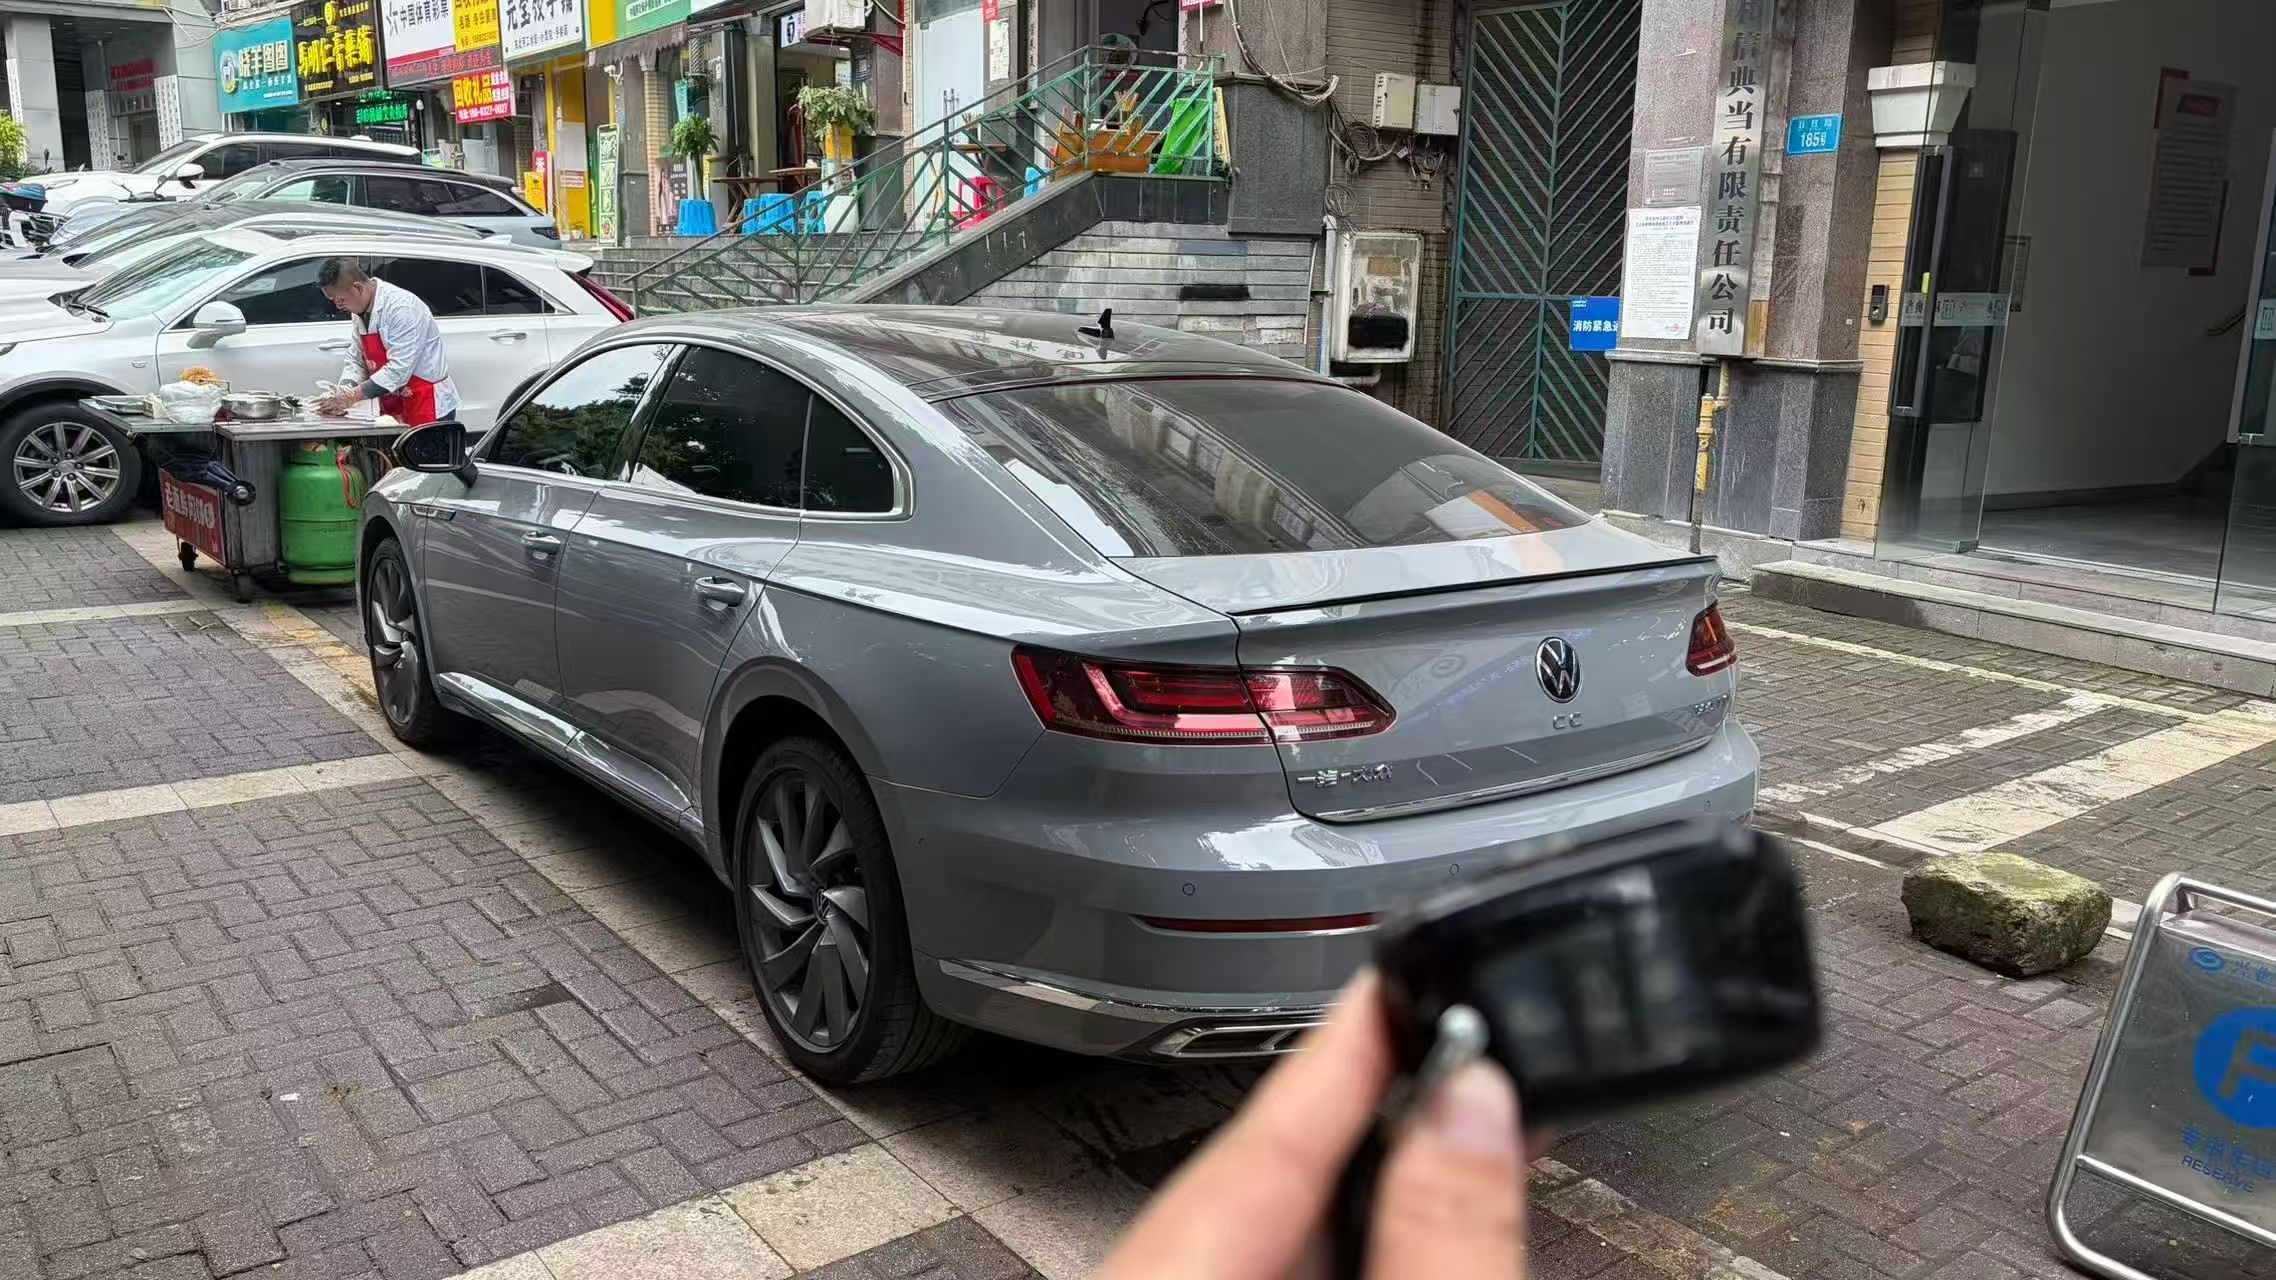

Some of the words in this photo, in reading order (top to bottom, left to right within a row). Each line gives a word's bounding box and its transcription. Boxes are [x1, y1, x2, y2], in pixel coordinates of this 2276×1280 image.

[453, 74, 493, 108] 回收礼品
[1800, 131, 1827, 147] 185号
[1552, 712, 1582, 729] CC
